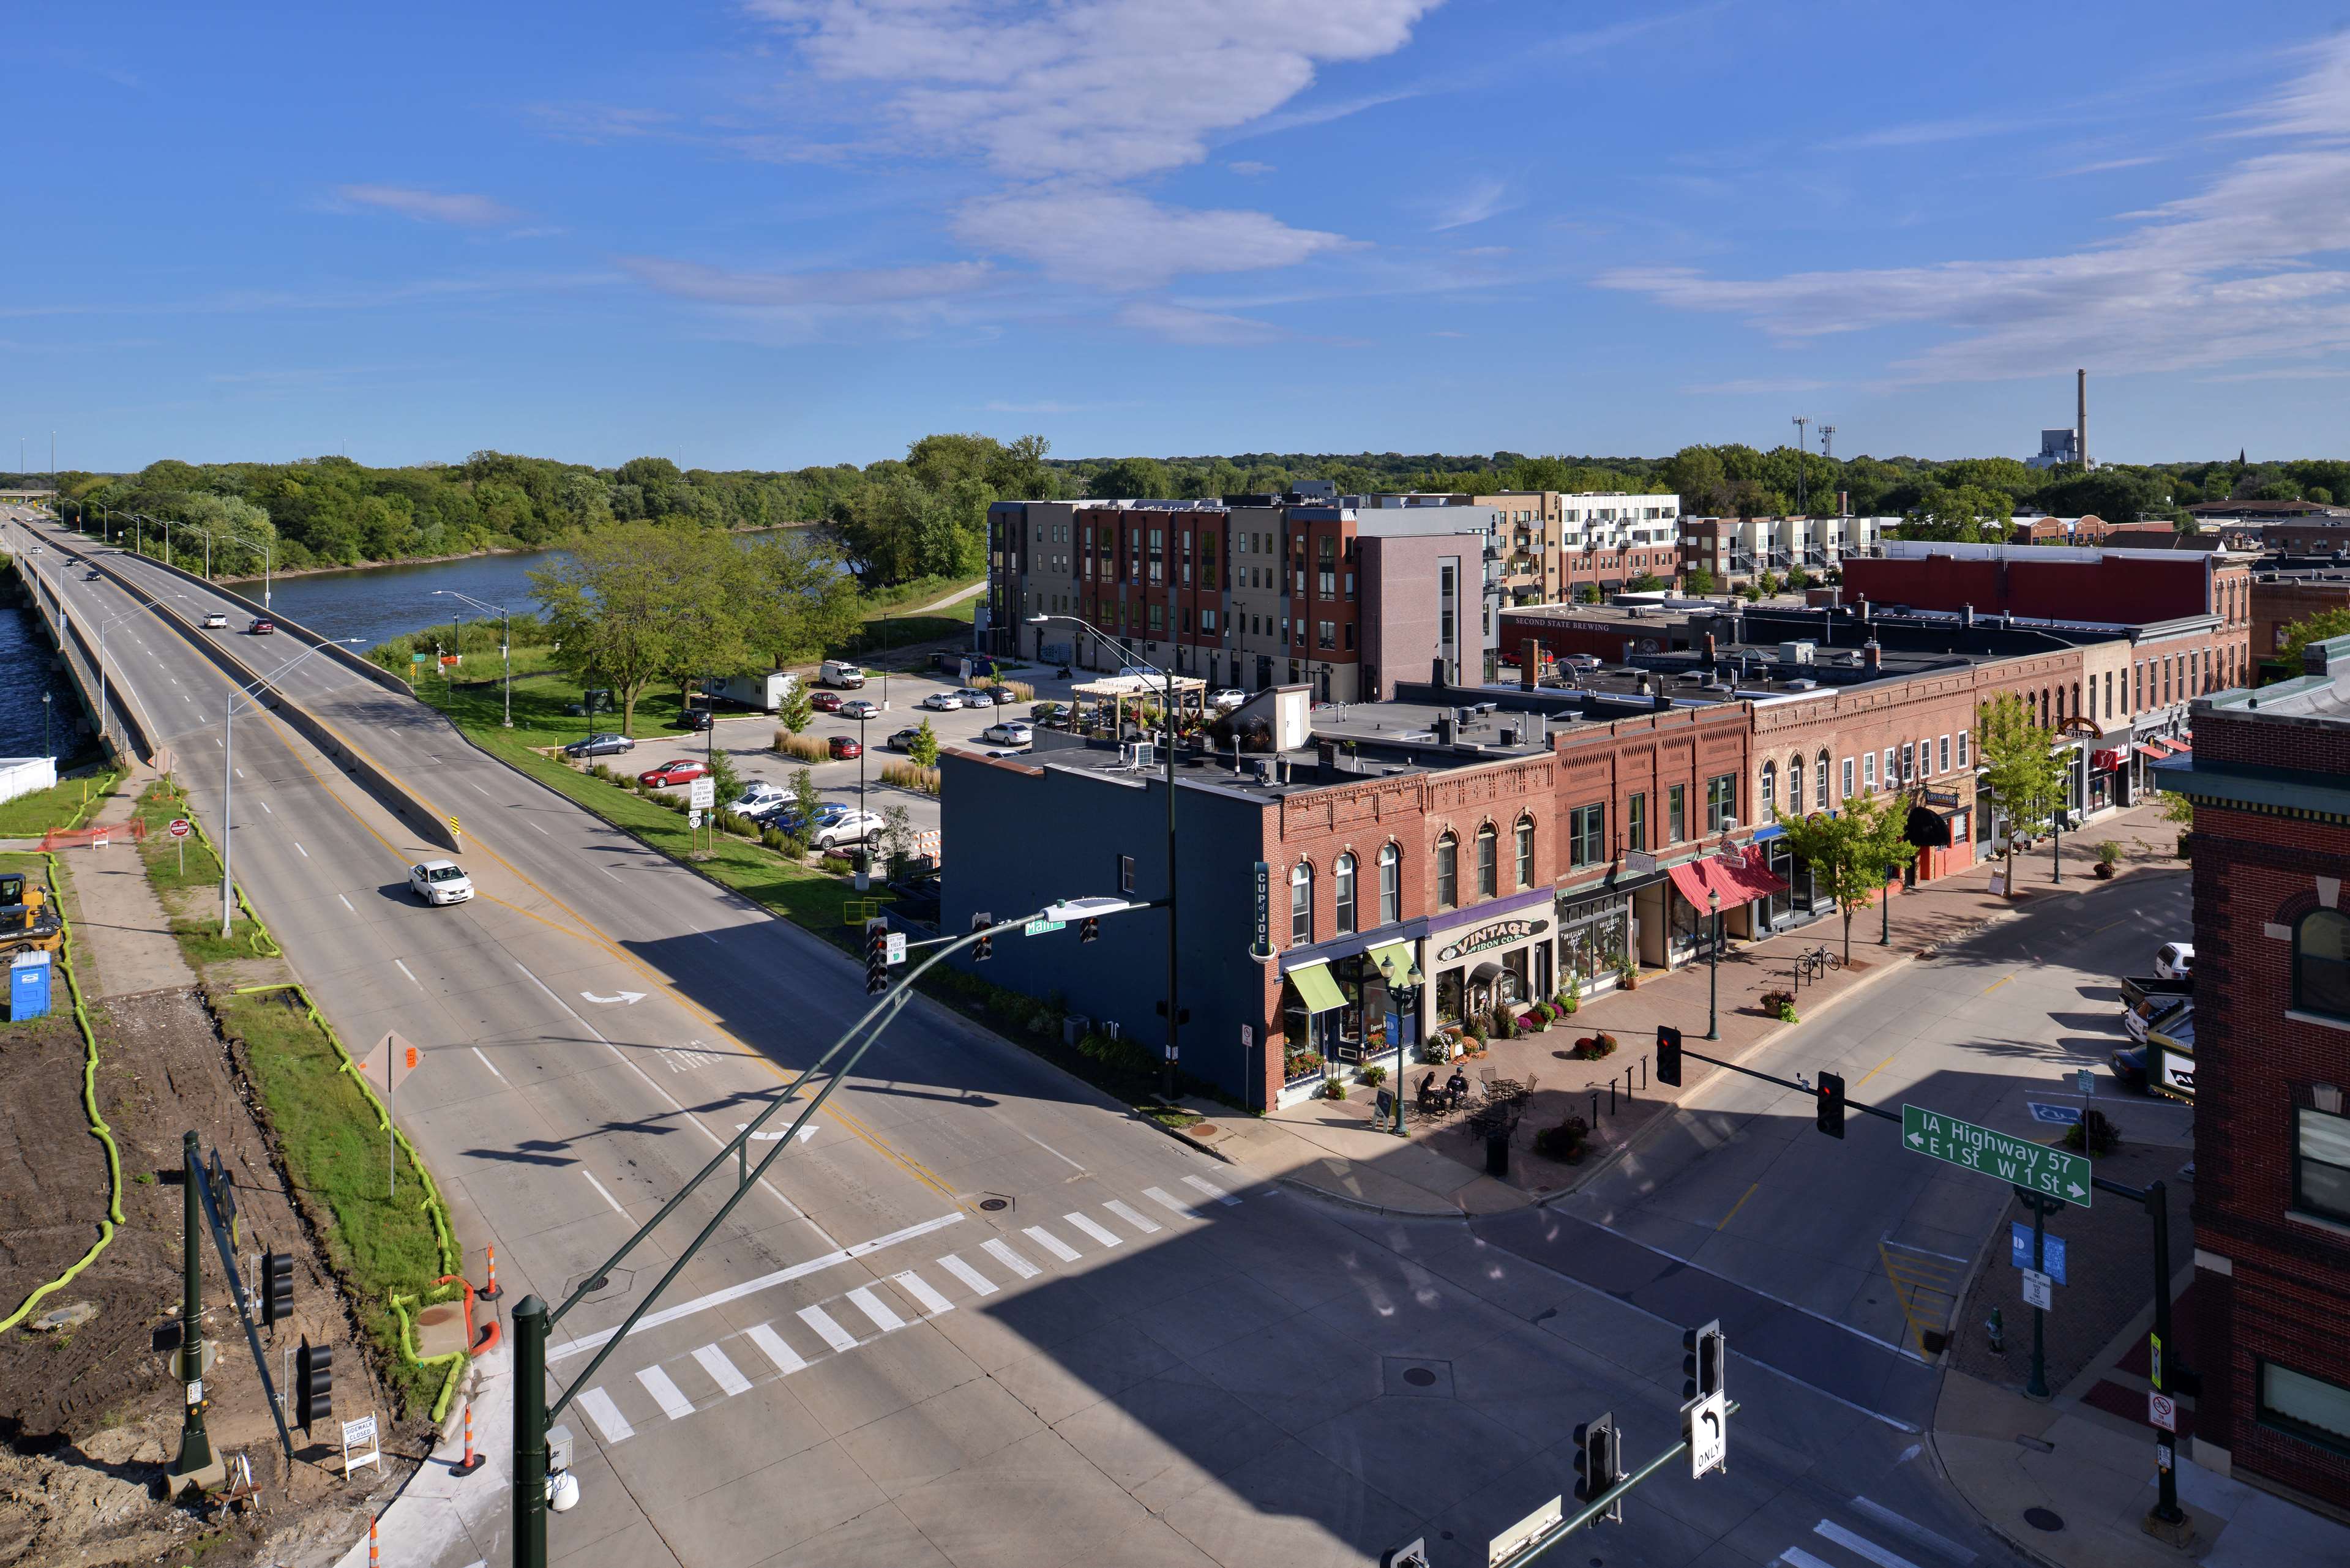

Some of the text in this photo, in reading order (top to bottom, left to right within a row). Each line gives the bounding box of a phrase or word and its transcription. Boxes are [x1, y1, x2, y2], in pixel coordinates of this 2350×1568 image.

[987, 607, 992, 622] CO
[1516, 617, 1609, 632] SECOND STATE BREWING
[1938, 794, 1956, 804] CABOS
[1257, 873, 1266, 903] CUP
[1258, 903, 1266, 912] of
[1456, 922, 1532, 955] VINTAGE
[1477, 935, 1515, 951] IRON CO.
[1922, 1113, 2071, 1174] IA Highway 57
[1929, 1137, 2060, 1194] E 1 St W 1 St
[345, 1421, 373, 1435] SIDEWALK
[350, 1429, 371, 1441] CLOSED
[1698, 1441, 1720, 1468] ONLY
